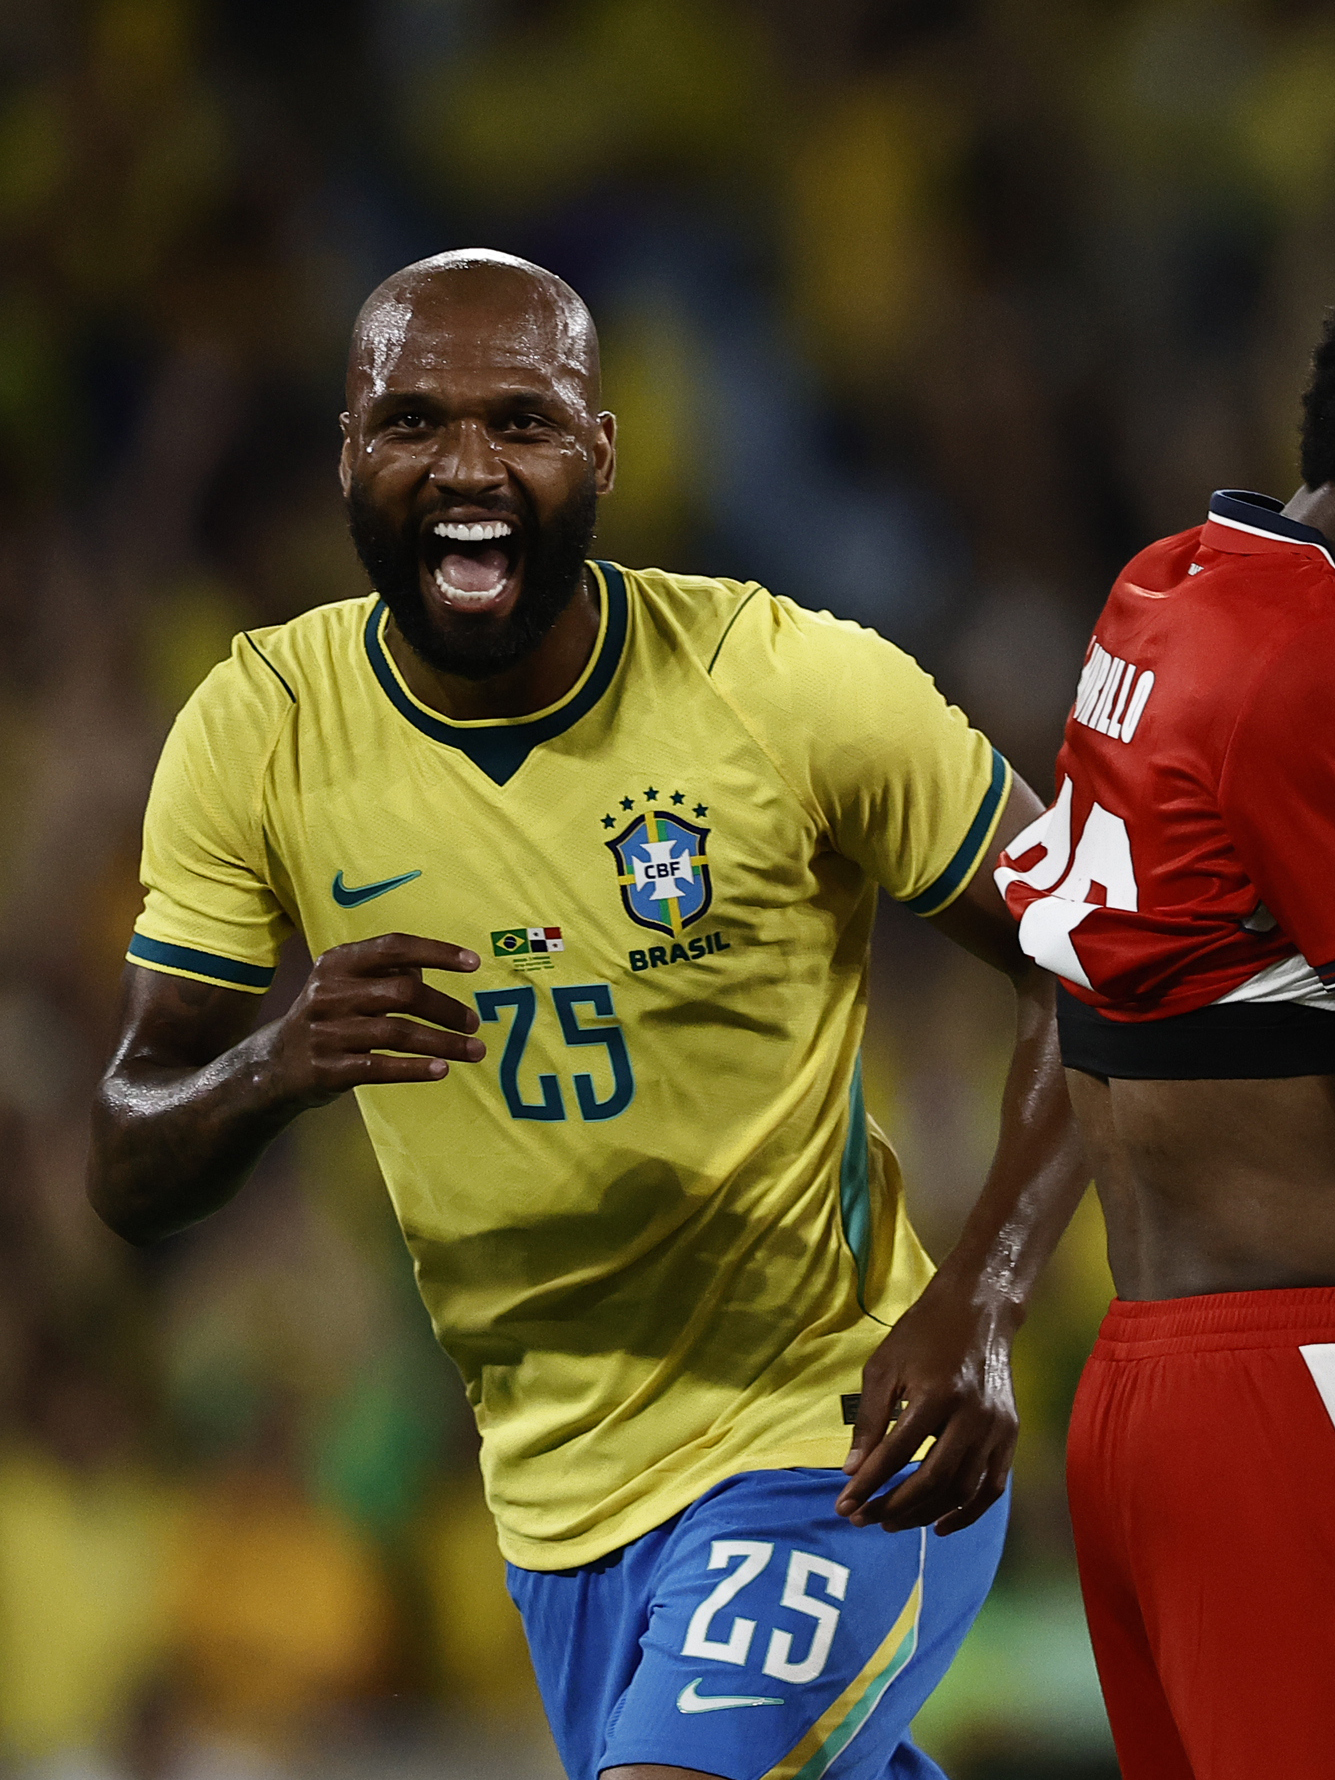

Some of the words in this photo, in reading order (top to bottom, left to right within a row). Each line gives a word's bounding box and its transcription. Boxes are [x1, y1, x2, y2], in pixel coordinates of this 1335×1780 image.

[644, 861, 681, 880] CBF
[628, 931, 731, 972] BRASIL
[473, 982, 636, 1122] 25
[680, 1539, 851, 1685] 25
